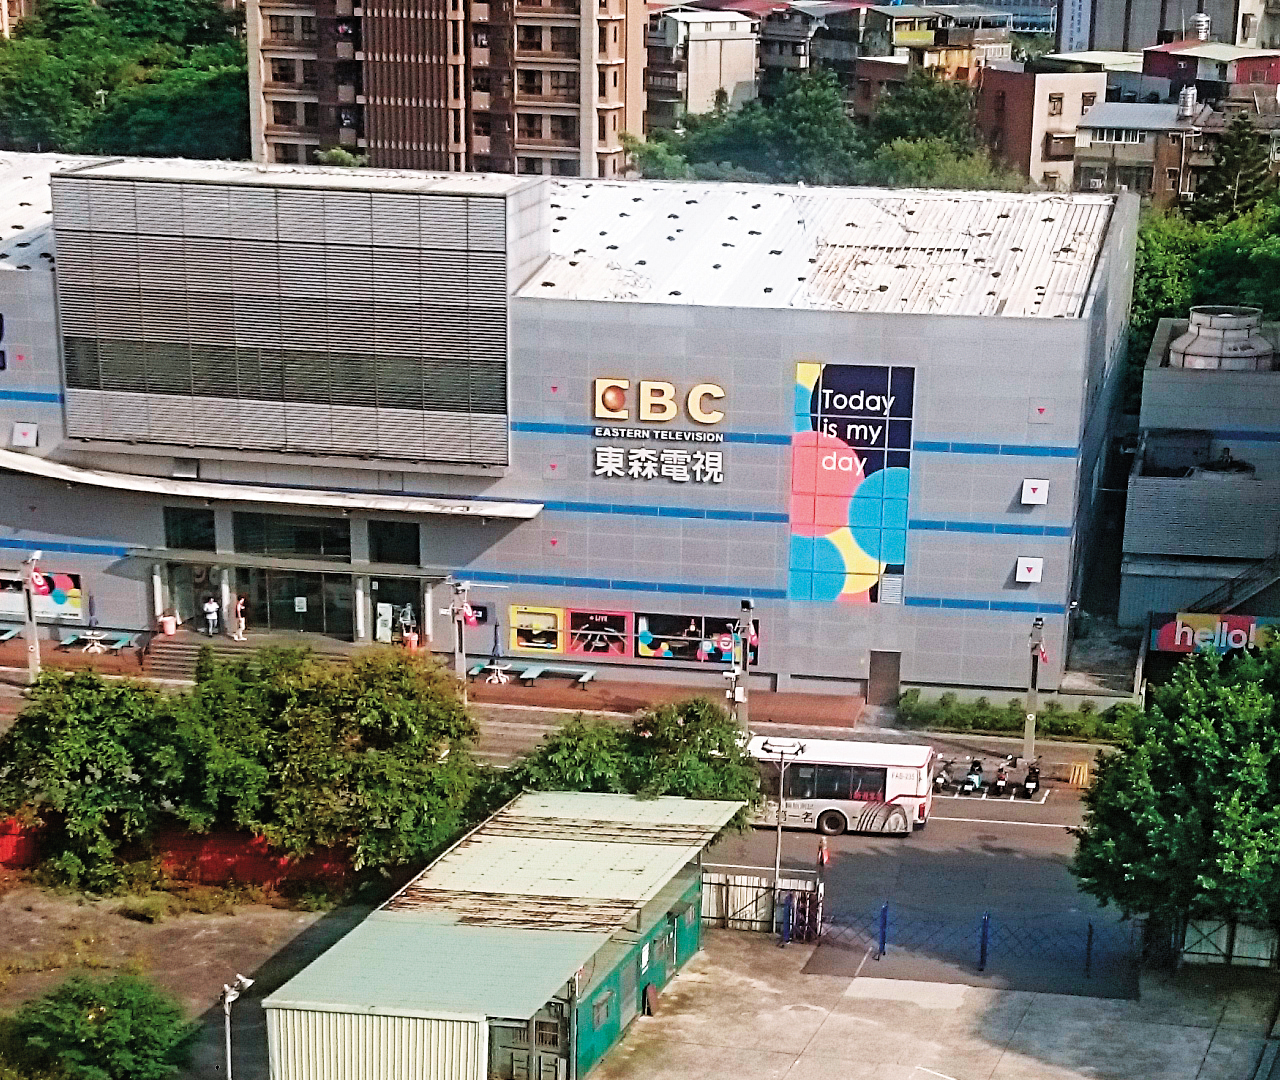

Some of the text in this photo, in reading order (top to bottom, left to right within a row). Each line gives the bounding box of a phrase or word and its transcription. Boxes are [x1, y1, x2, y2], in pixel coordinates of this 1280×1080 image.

[595, 378, 725, 424] EBC
[822, 389, 896, 416] Today
[595, 427, 724, 442] EASTERN TELEVISION
[823, 418, 883, 445] is my
[595, 446, 724, 483] 東森電視
[822, 451, 868, 476] day
[1174, 621, 1256, 649] hello!
